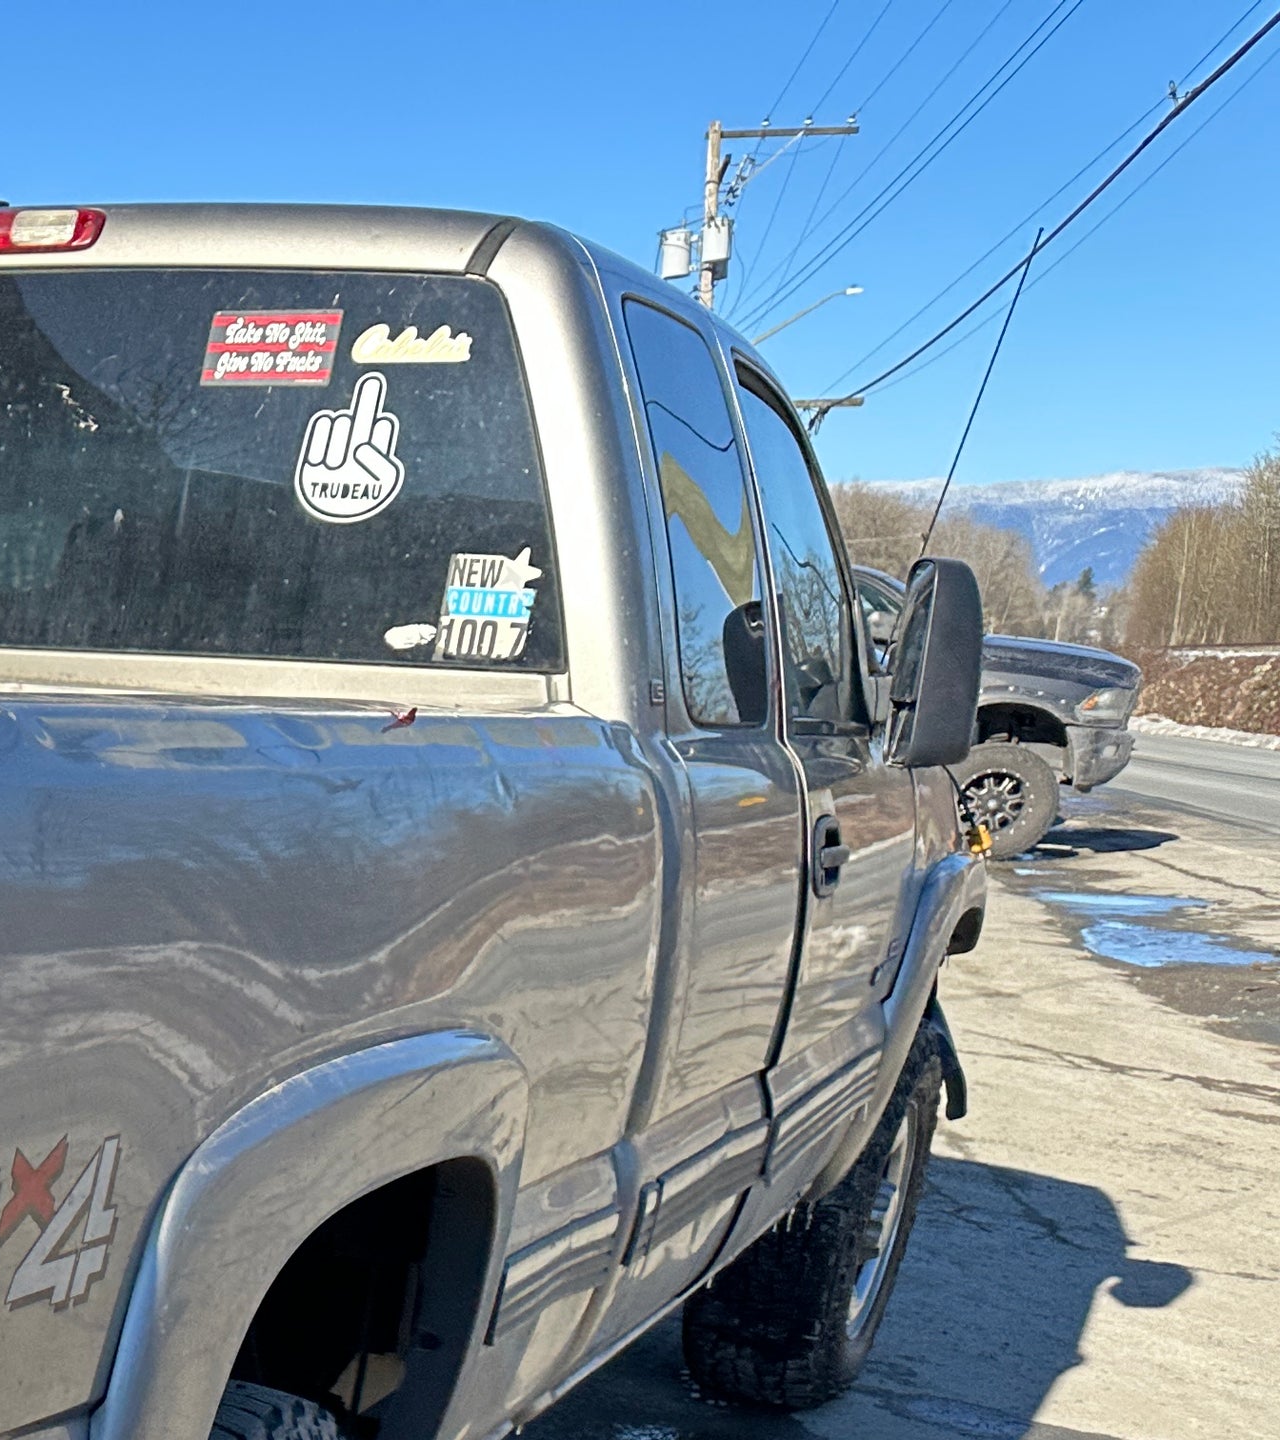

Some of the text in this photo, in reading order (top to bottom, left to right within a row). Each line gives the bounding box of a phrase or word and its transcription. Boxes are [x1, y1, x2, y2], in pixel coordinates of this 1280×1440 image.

[225, 316, 264, 345] Take
[265, 321, 291, 344] No
[213, 350, 322, 380] Give No Fucks
[310, 481, 383, 500] TRUDEAU
[449, 557, 505, 589] NEW
[443, 618, 528, 661] 100.7
